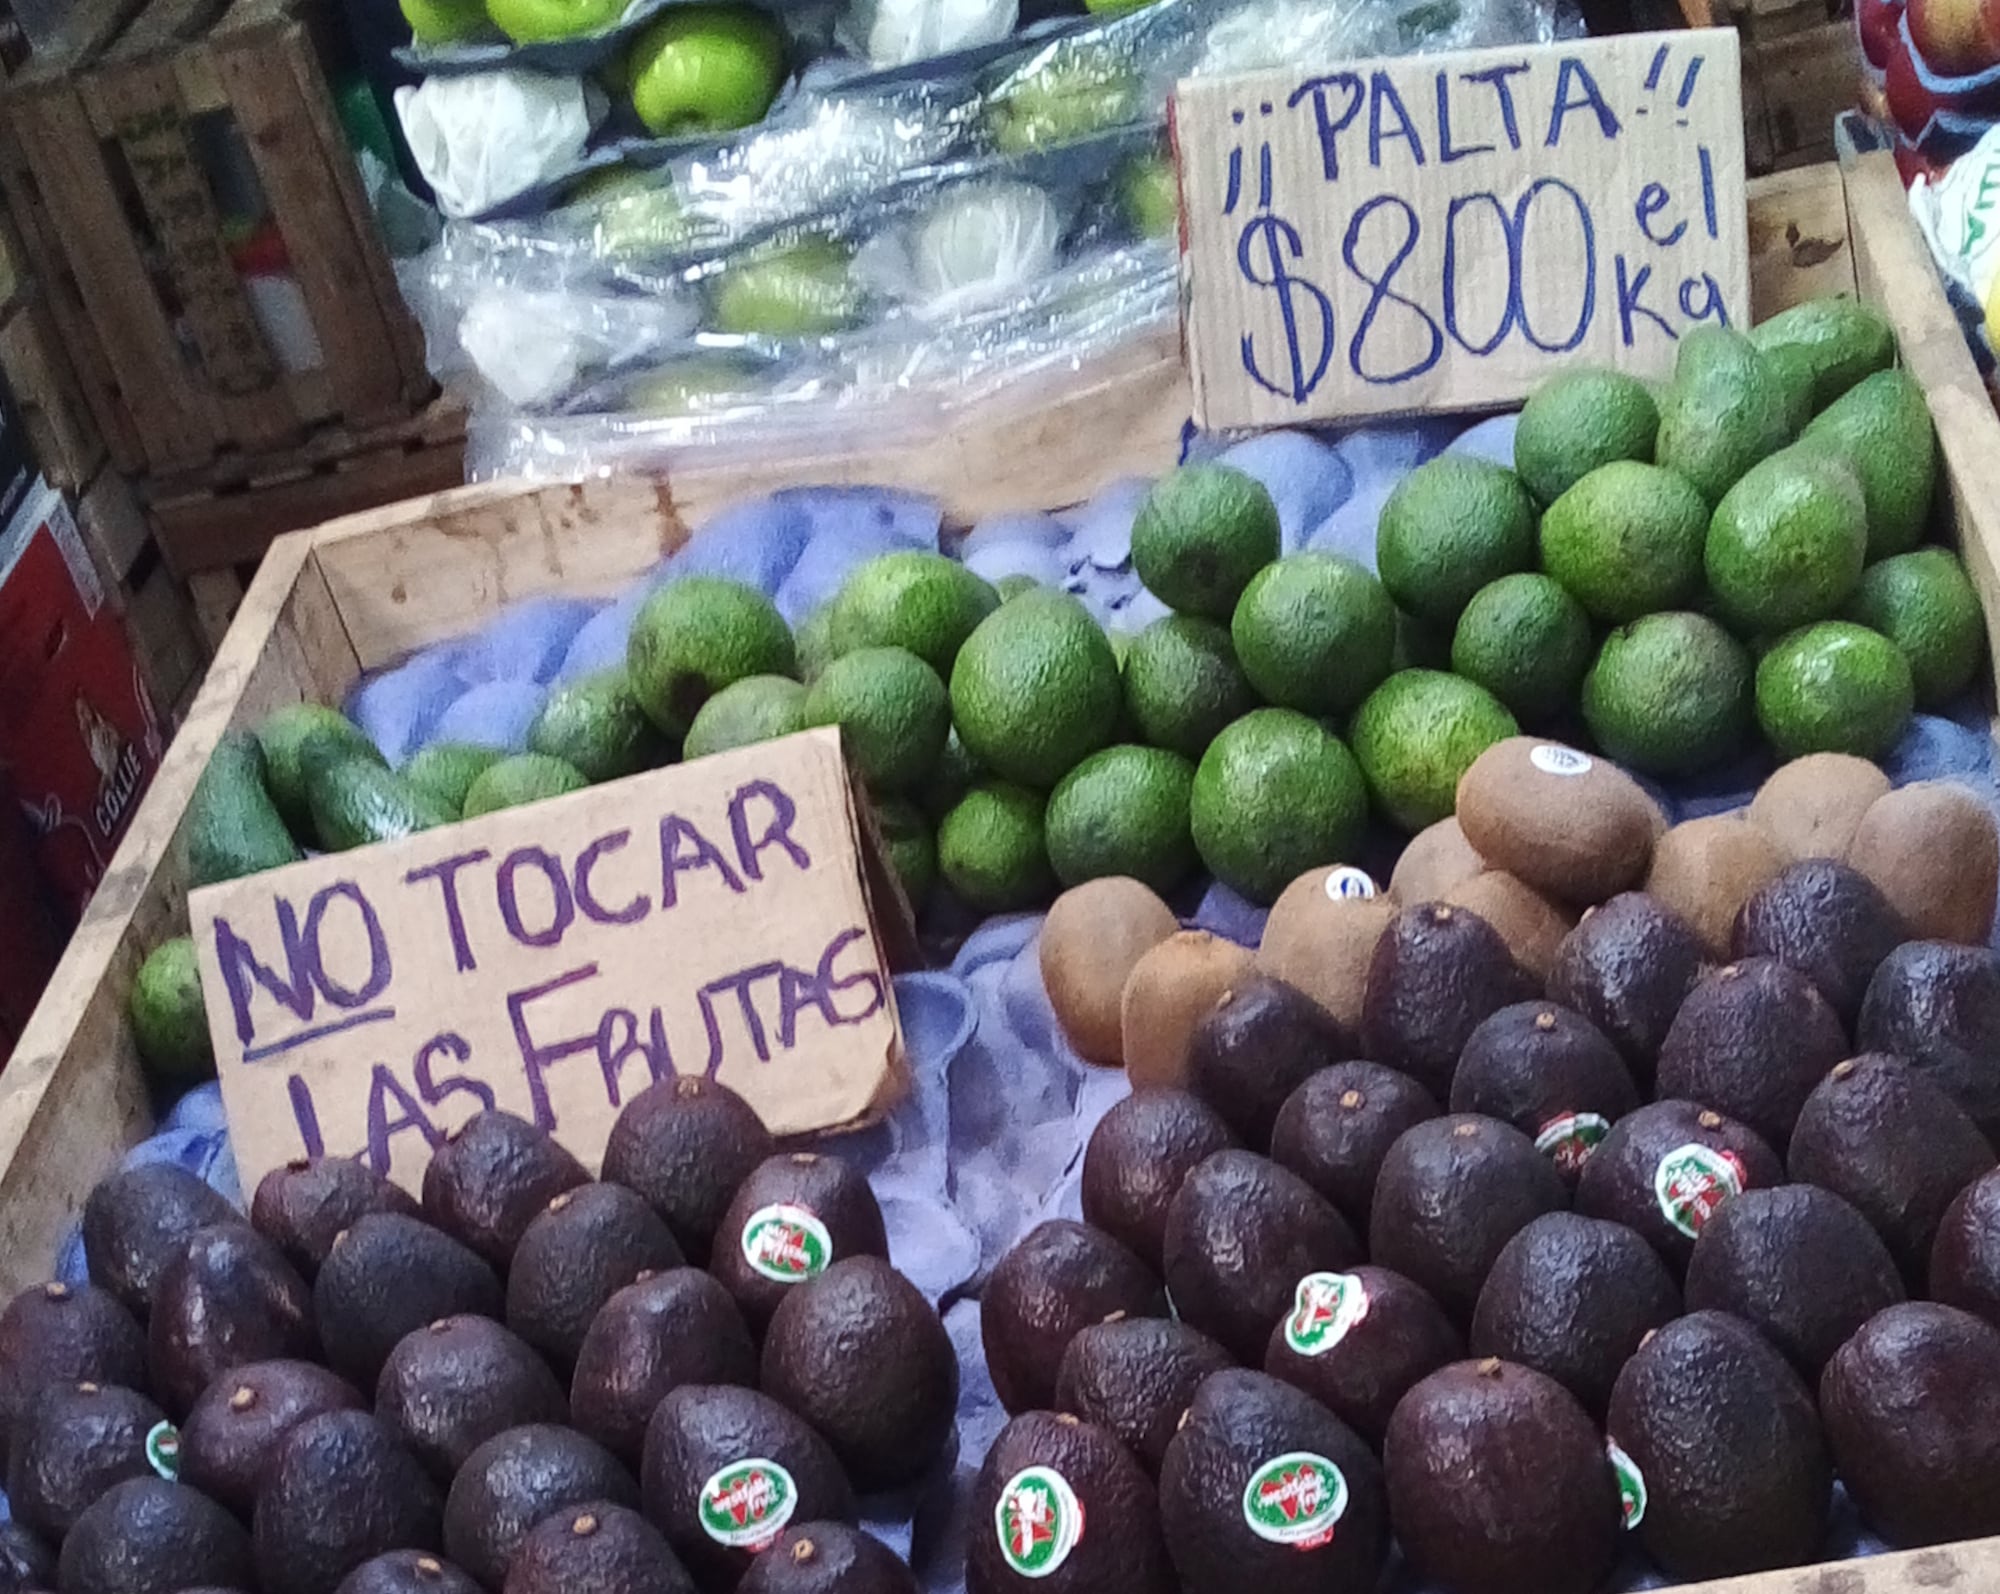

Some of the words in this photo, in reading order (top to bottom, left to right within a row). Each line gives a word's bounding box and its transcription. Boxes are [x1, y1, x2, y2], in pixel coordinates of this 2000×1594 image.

[1236, 176, 1596, 405] $800
[1635, 144, 1718, 246] el
[213, 880, 392, 1046] NO
[405, 778, 811, 972] TOCAR
[506, 926, 886, 1132] FRUTAS
